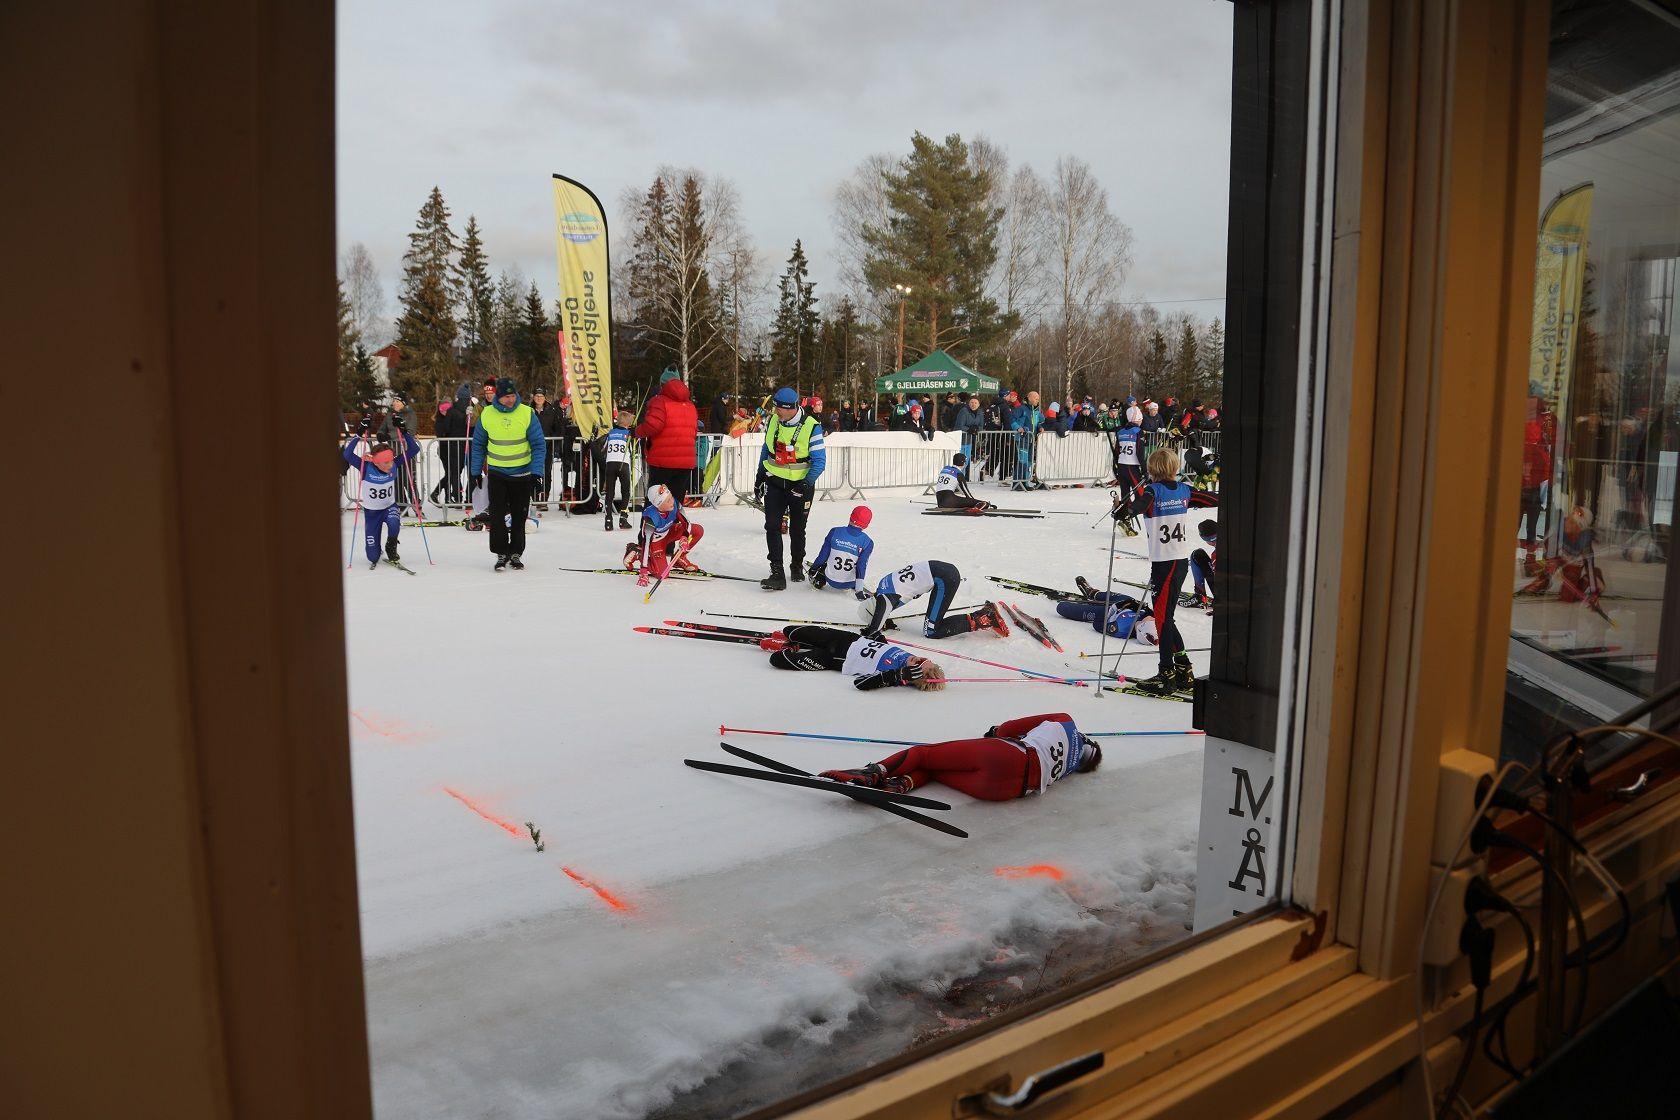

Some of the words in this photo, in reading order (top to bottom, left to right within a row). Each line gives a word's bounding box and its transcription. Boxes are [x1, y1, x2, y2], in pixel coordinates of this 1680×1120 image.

[896, 379, 944, 390] GJELLERÅSEN
[944, 380, 956, 388] SKI
[607, 443, 626, 454] 338
[369, 485, 393, 500] 380
[1159, 522, 1186, 544] 34
